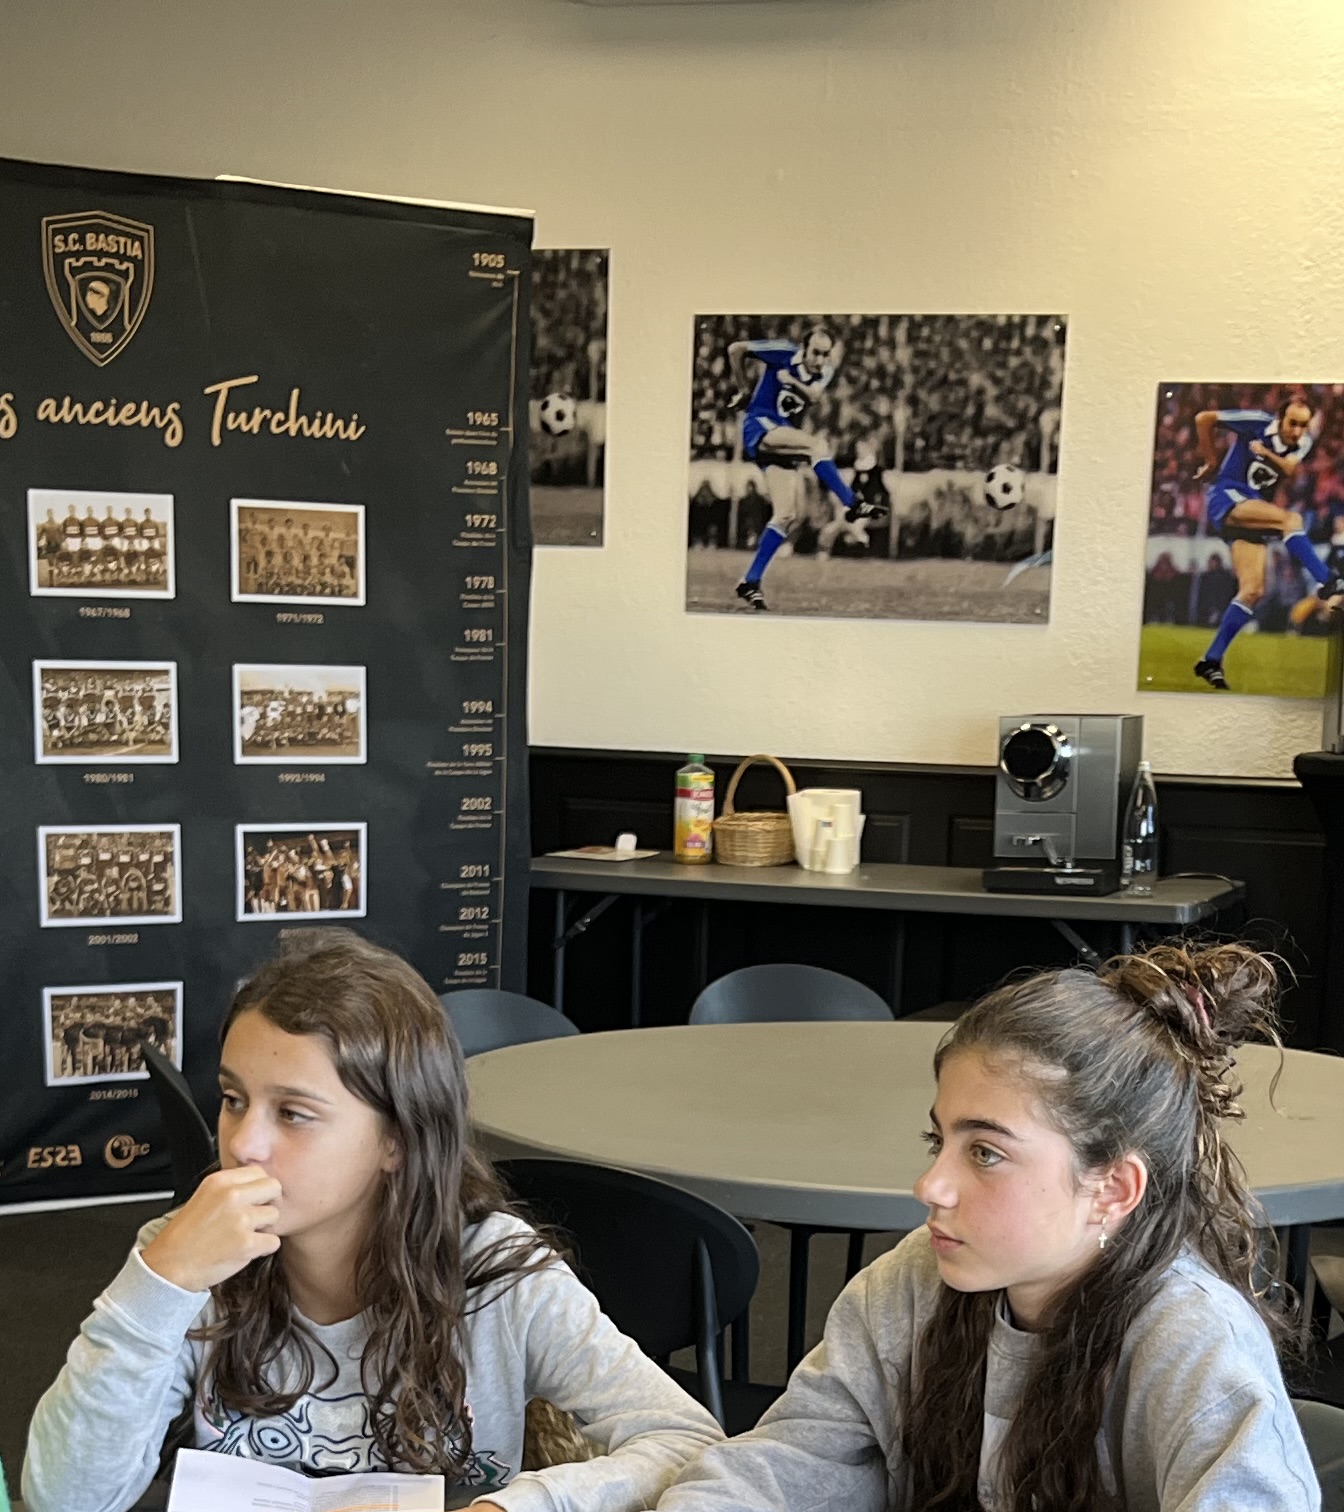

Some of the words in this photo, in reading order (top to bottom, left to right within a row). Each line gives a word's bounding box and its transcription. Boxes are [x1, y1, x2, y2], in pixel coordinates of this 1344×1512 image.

[54, 232, 84, 253] S.C.
[85, 232, 143, 260] BASTIA
[472, 252, 505, 268] 1905
[36, 395, 185, 448] anciens
[203, 374, 367, 446] Turchini
[467, 411, 499, 426] 1965
[466, 461, 498, 475] 1968
[465, 514, 497, 528] 1972
[464, 576, 495, 589] 1978
[464, 629, 493, 642] 1981
[462, 700, 493, 713] 1994
[462, 743, 493, 757] 1995
[461, 797, 493, 810] 2002
[460, 864, 490, 878] 2011
[459, 907, 490, 921] 2012
[457, 953, 488, 966] 2015
